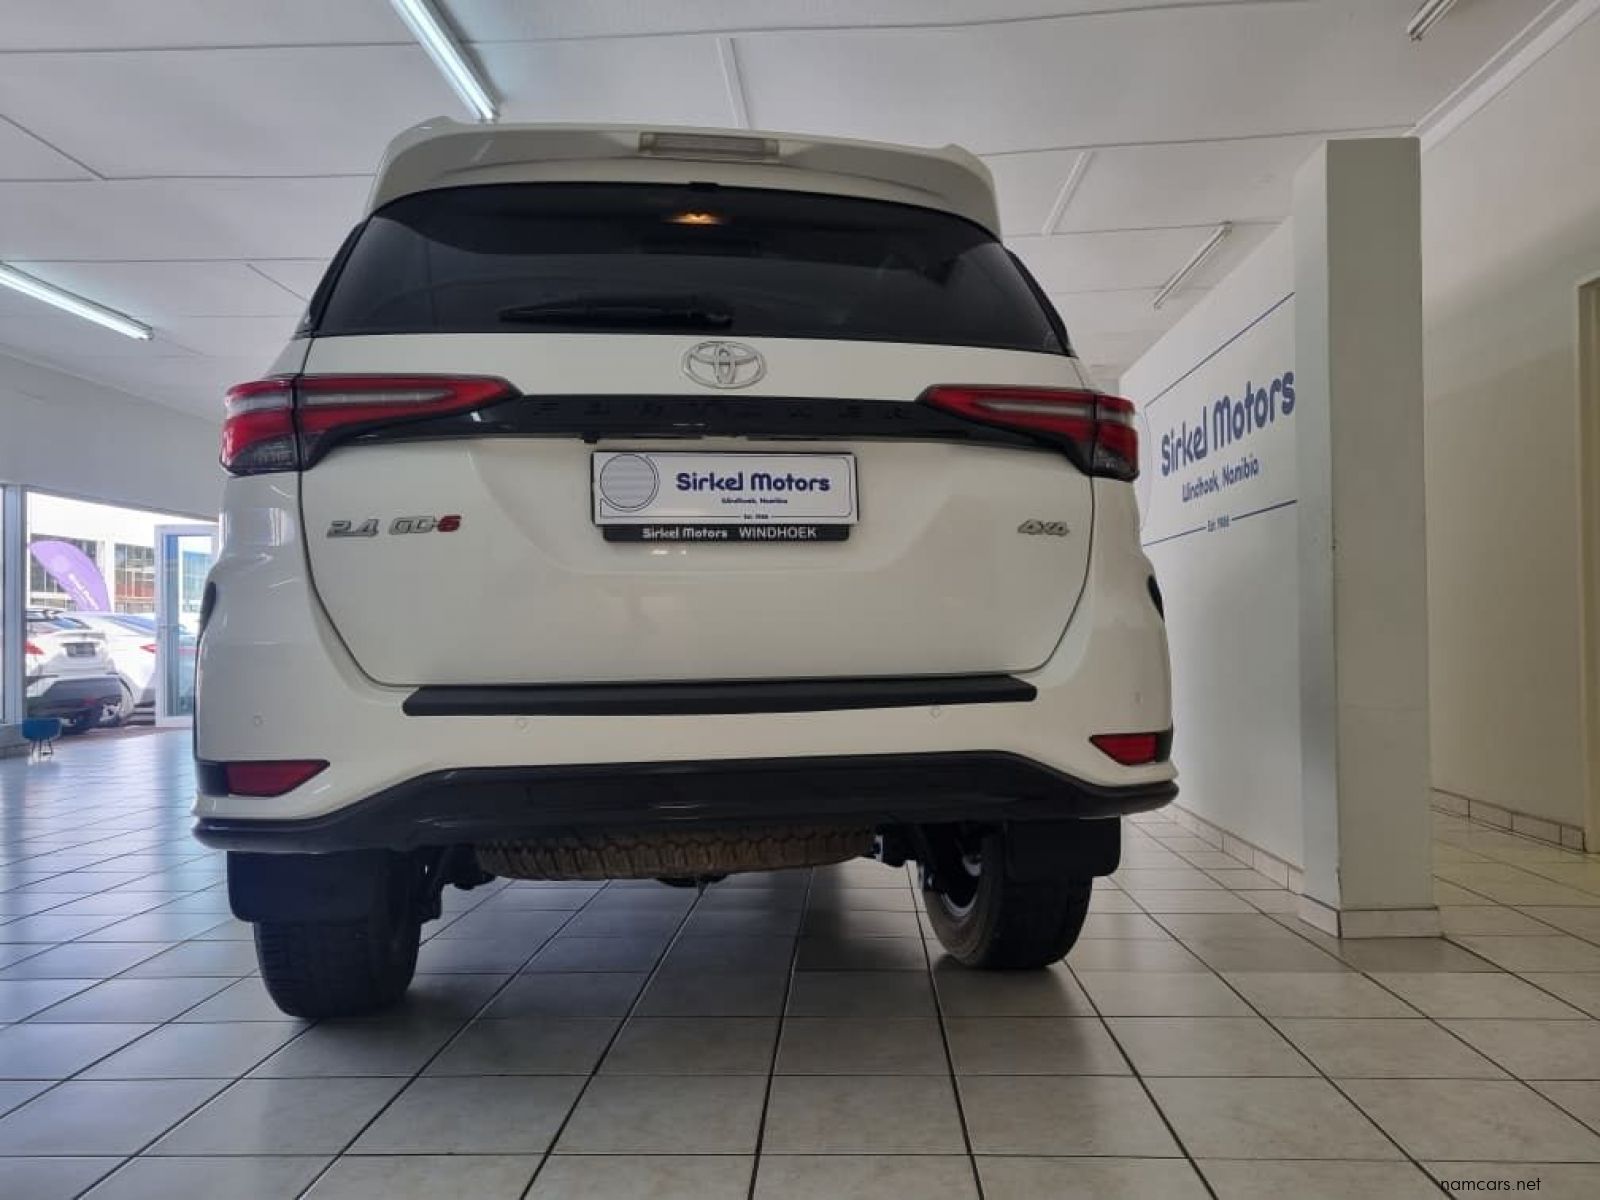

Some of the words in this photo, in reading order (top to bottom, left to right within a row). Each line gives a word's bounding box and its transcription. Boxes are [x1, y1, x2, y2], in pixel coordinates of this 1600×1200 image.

[1161, 406, 1207, 477] Sirkel
[1213, 371, 1296, 451] Motors
[676, 472, 744, 491] Sirkel
[750, 472, 831, 491] Motors
[1222, 453, 1260, 490] Namibia
[326, 518, 379, 538] 2.4
[642, 527, 679, 538] Sirkel
[682, 527, 728, 538] Motors
[739, 526, 817, 538] WINDHOEK
